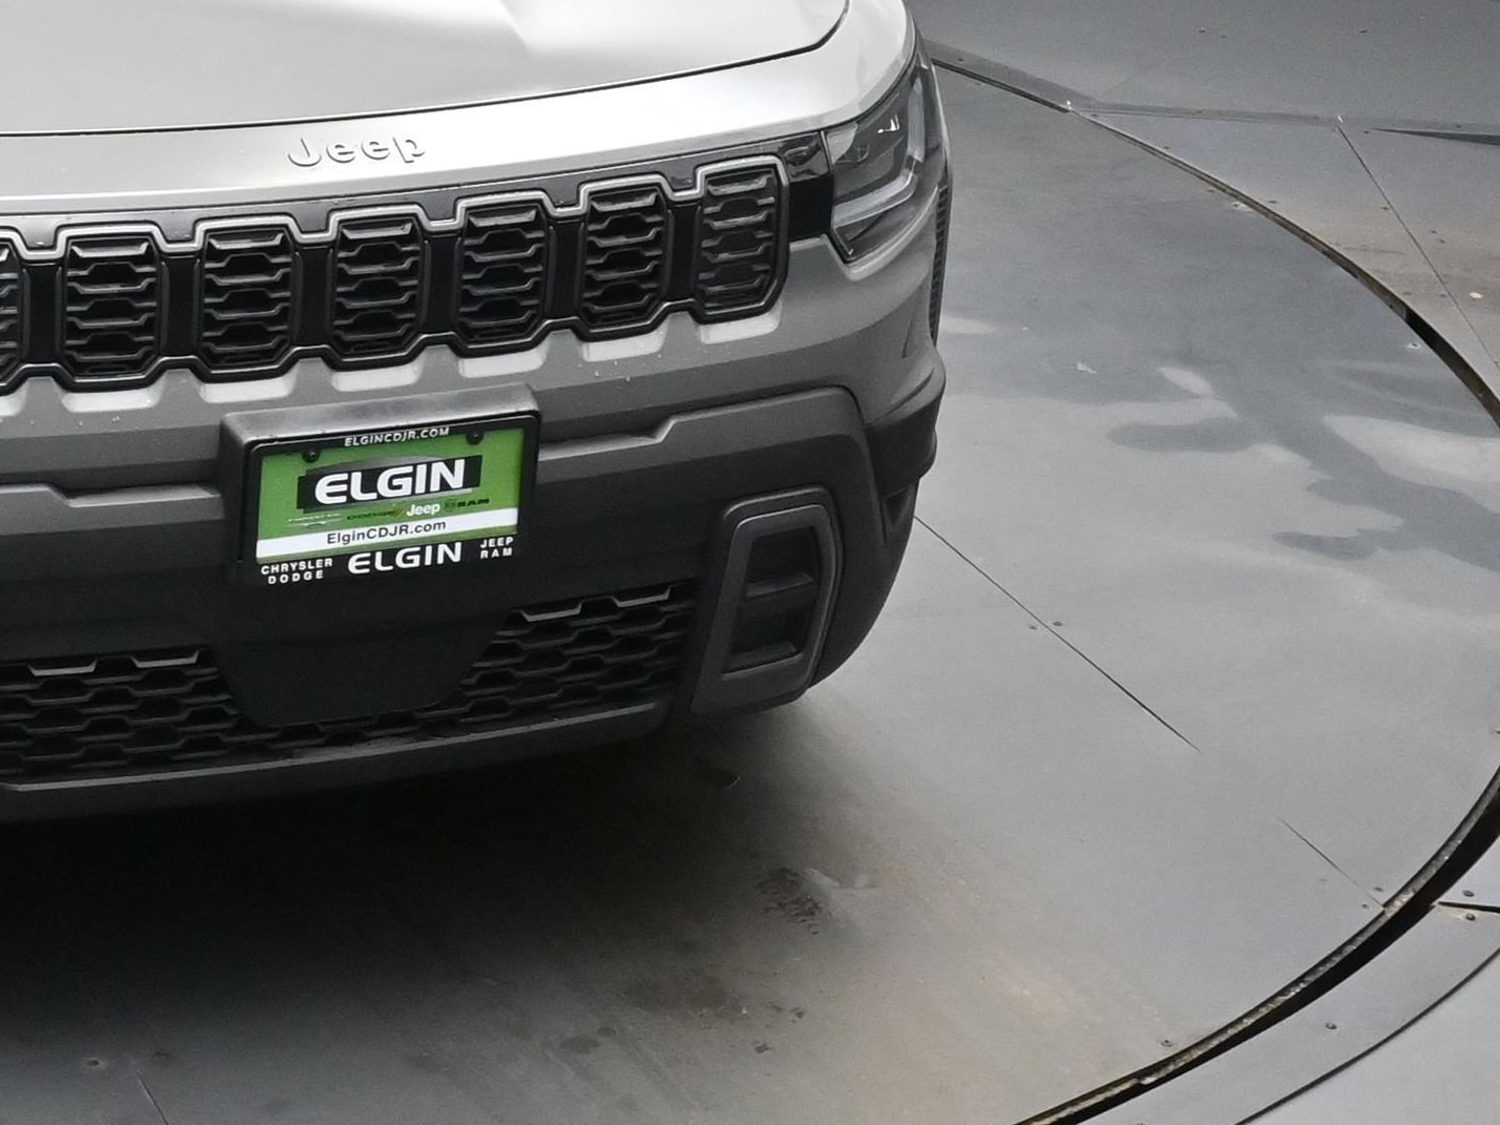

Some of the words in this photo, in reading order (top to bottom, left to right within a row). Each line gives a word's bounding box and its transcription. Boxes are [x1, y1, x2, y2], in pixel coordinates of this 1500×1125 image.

[287, 136, 426, 168] Jeep
[344, 427, 450, 448] ELGINCDJR.COM
[314, 458, 466, 506] ELGIN
[406, 503, 441, 517] Jeep
[326, 520, 447, 545] ElginCDJR.com
[480, 536, 514, 549] JEEP
[348, 542, 462, 575] ELGIN
[480, 547, 513, 559] RAM
[261, 557, 333, 576] CHRYSLER
[268, 570, 324, 585] DODGE
